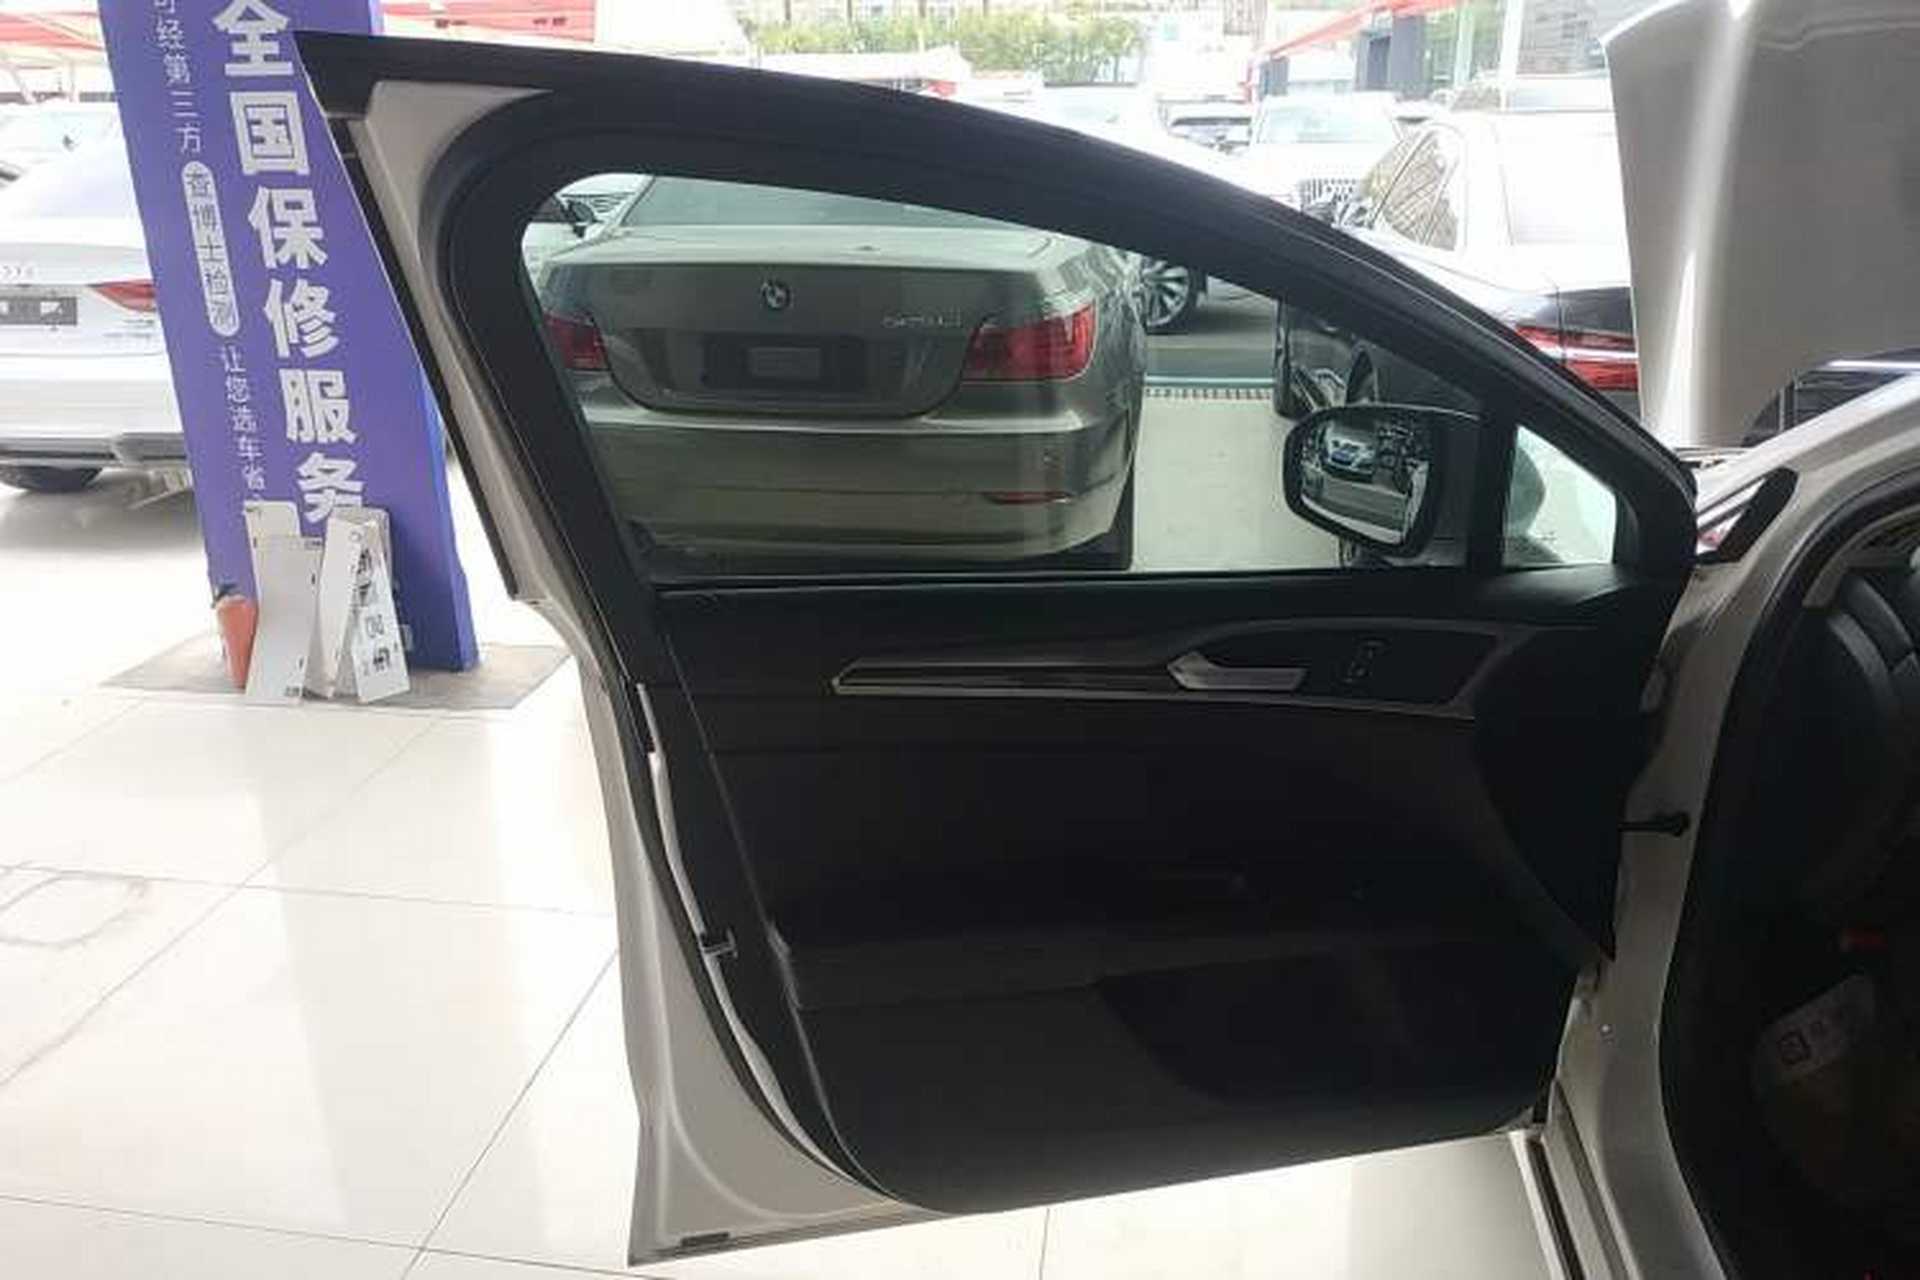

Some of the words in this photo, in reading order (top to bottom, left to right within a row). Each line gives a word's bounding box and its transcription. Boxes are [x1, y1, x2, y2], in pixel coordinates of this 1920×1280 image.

[212, 0, 366, 524] 全国保修服务
